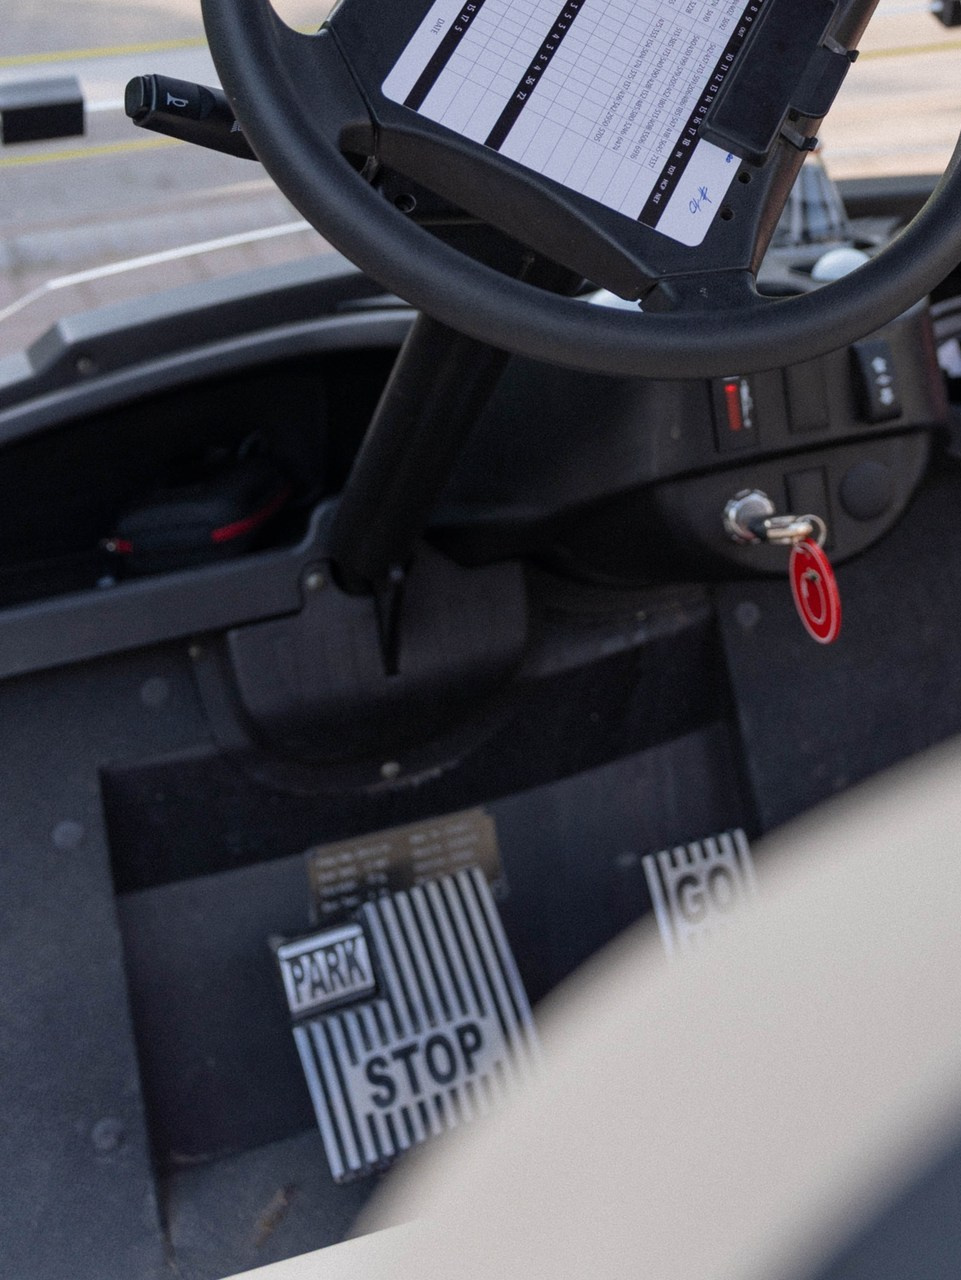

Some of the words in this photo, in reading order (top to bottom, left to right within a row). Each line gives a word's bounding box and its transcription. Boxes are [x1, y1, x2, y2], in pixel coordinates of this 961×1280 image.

[466, 3, 476, 12] 15
[569, 1, 578, 9] 3
[460, 13, 469, 22] 17
[430, 17, 445, 34] DATE
[724, 52, 734, 62] 10
[719, 63, 728, 71] 11
[524, 75, 535, 86] 36
[714, 73, 723, 82] 12
[708, 83, 718, 92] 13
[515, 90, 526, 101] 72
[703, 94, 713, 103] 14
[698, 104, 707, 113] 15
[692, 115, 702, 125] 16
[687, 126, 696, 135] 17
[681, 137, 691, 146] 18
[676, 865, 735, 924] GO
[292, 940, 368, 1003] PARK
[364, 1021, 485, 1108] STOP
